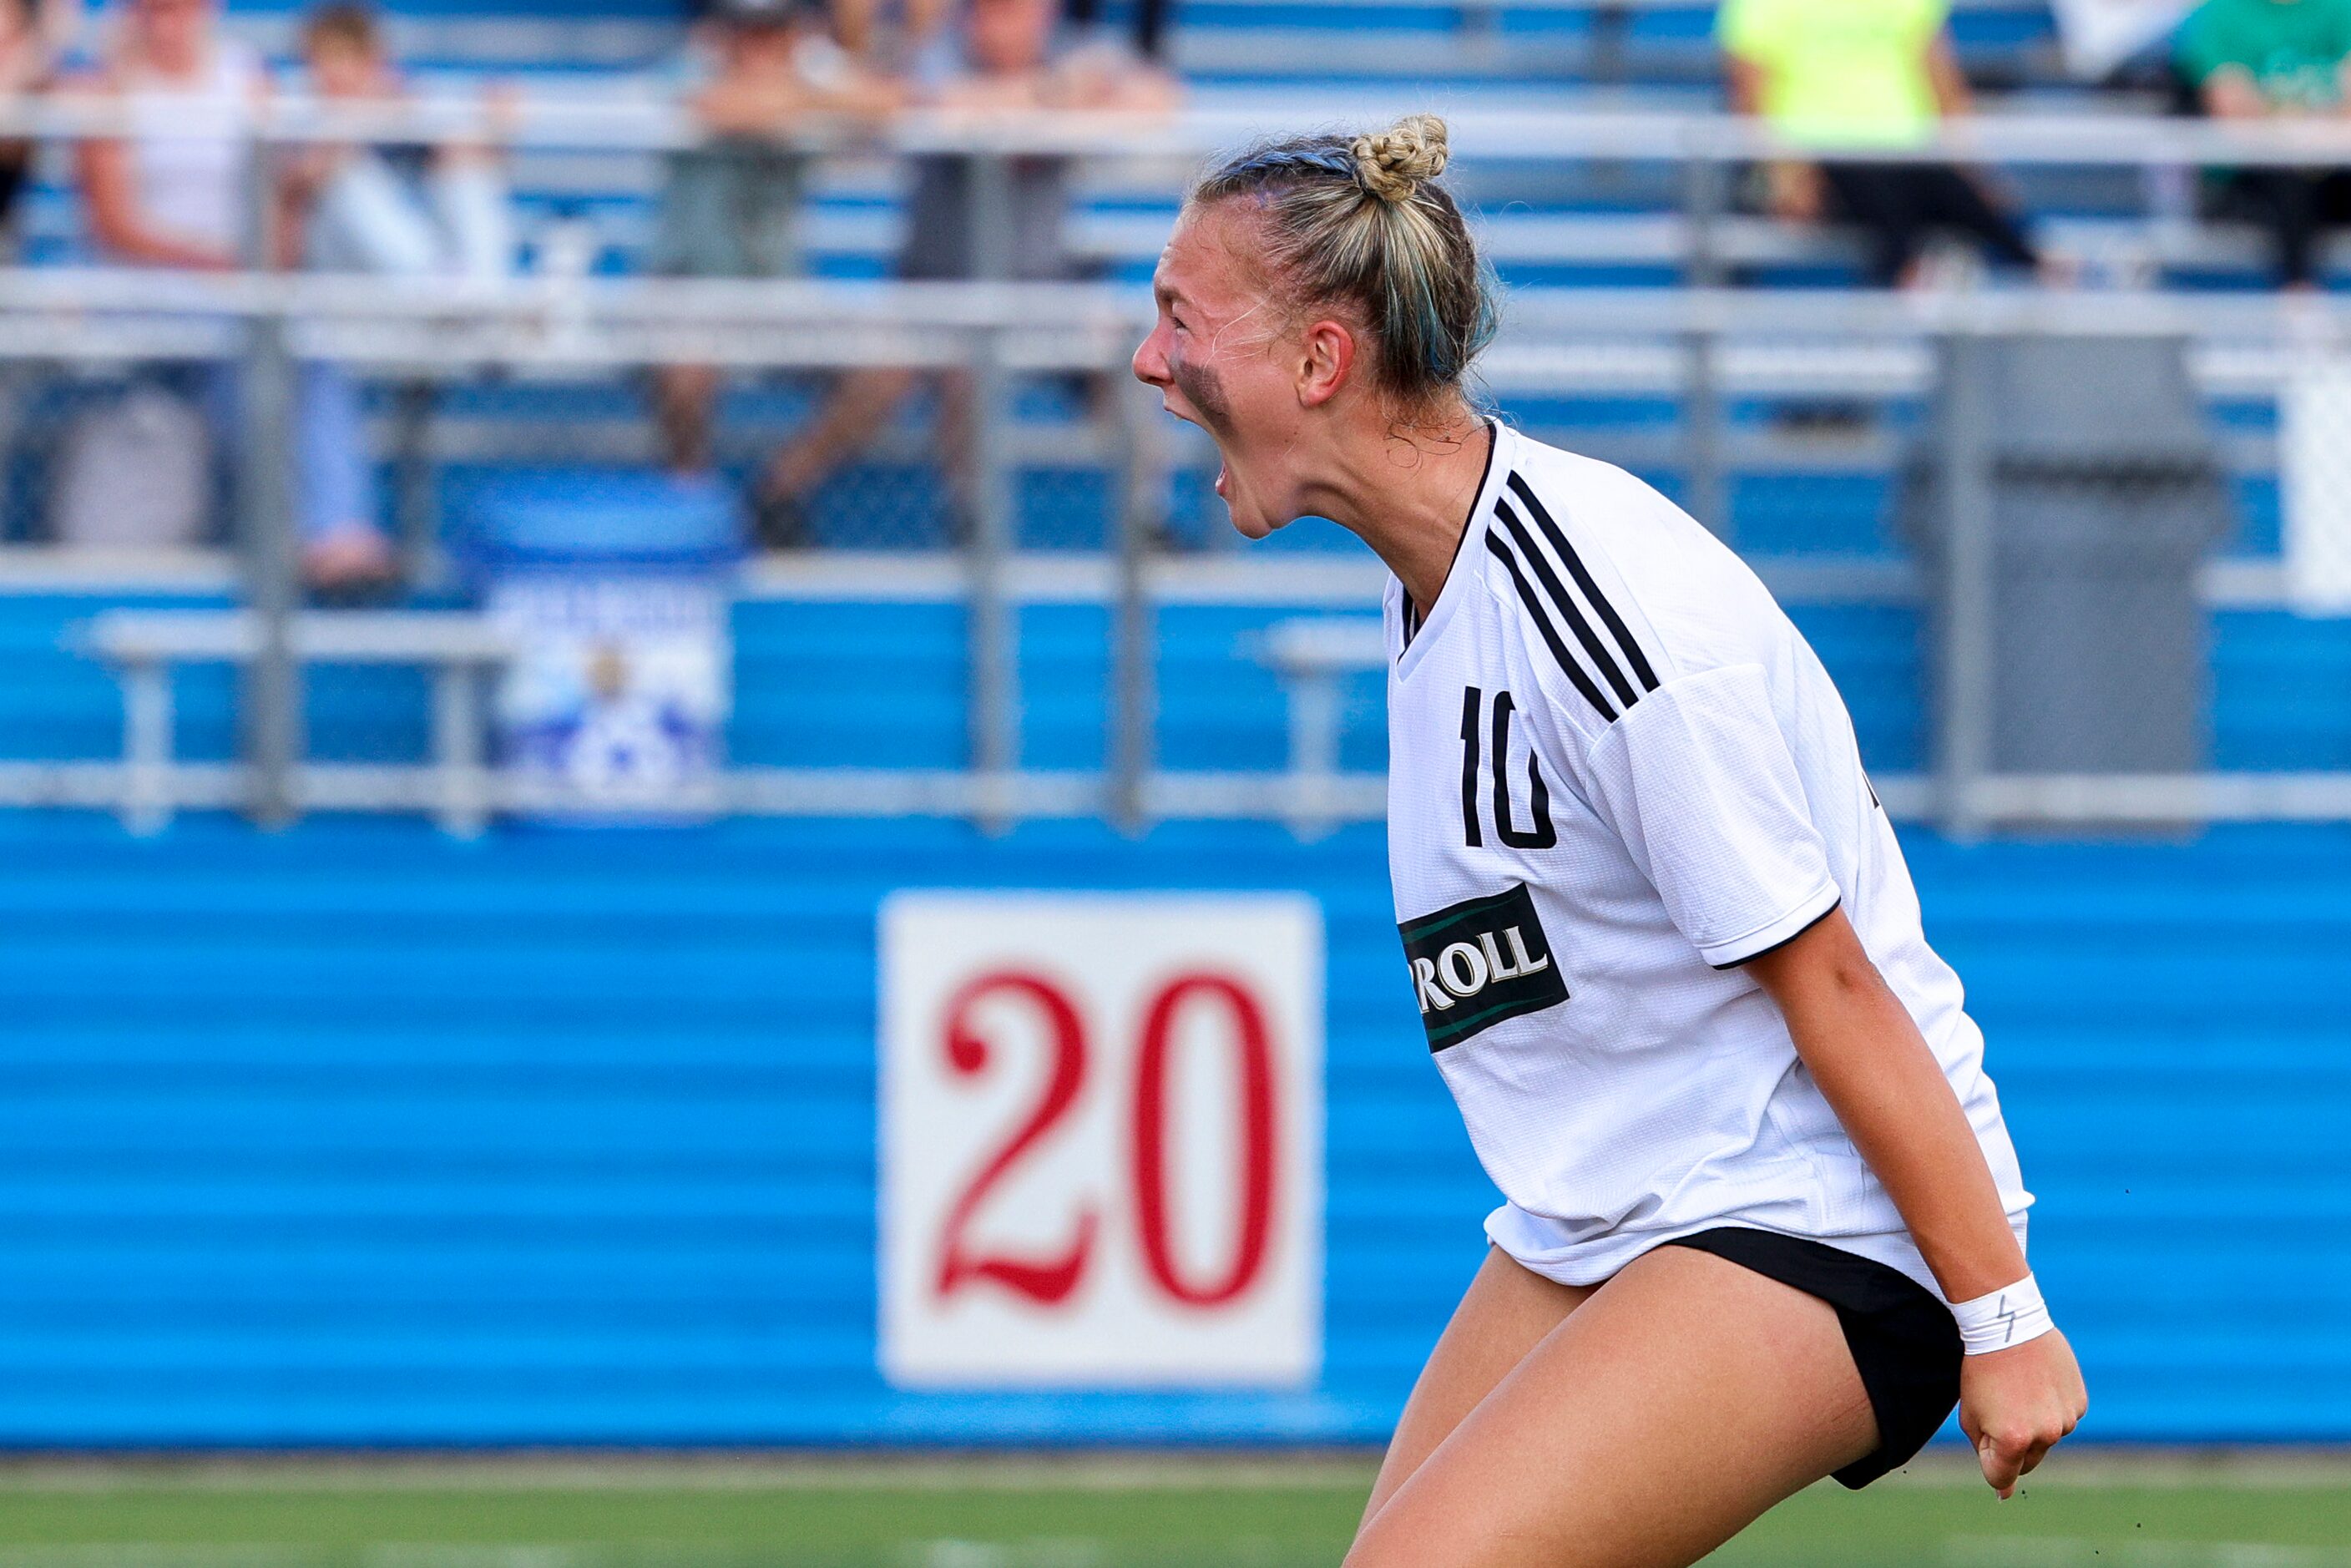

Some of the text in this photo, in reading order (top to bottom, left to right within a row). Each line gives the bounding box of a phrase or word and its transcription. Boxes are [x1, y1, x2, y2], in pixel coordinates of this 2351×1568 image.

[1460, 685, 1558, 850] 10
[1408, 925, 1549, 1014] ROLL
[935, 965, 1277, 1308] 20
